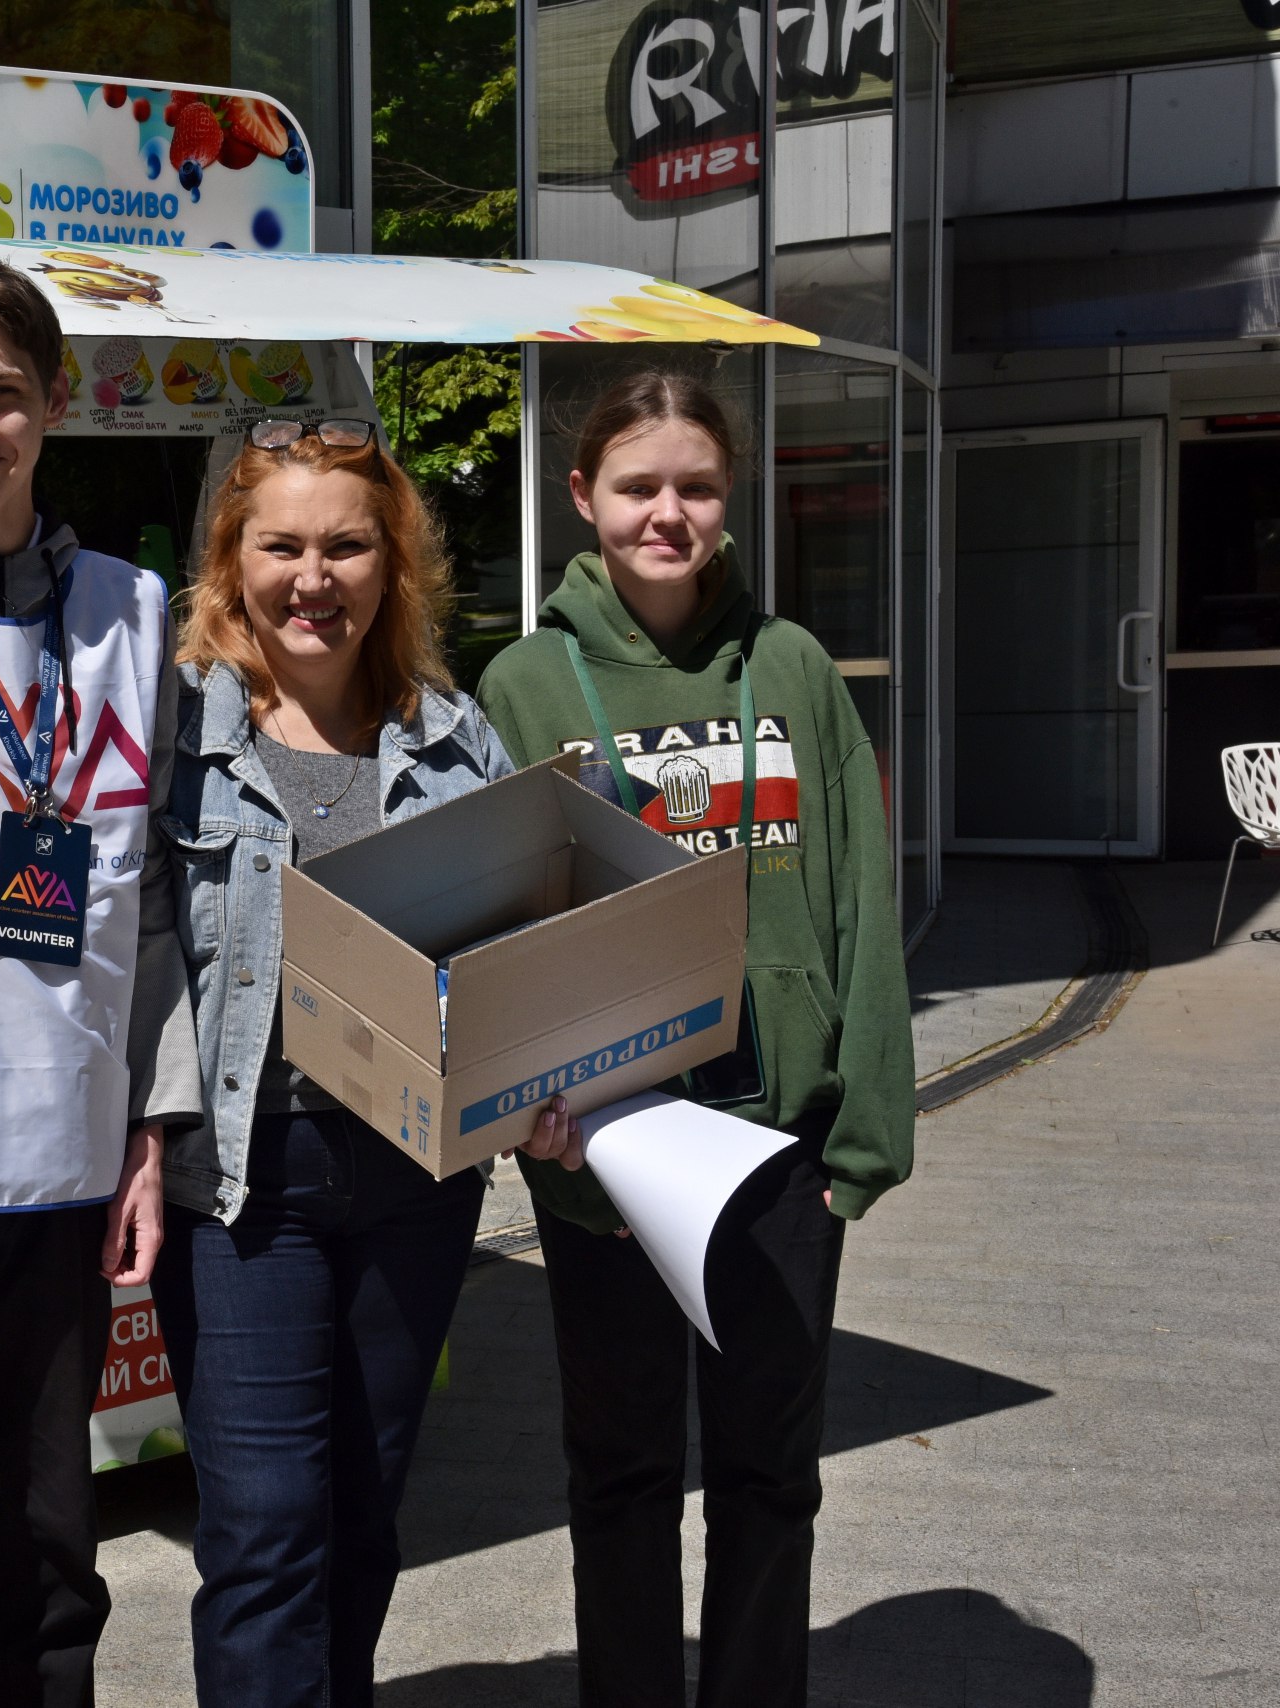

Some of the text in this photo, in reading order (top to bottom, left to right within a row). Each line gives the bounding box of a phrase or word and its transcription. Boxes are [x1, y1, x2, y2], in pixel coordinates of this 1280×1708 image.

[29, 183, 179, 220] МОРОЗИВО
[103, 421, 167, 432] ЦУКРОВОЇ ВАТИ
[121, 411, 145, 419] СМАК
[191, 410, 220, 419] МАНГО
[41, 667, 50, 698] Kharkiv
[2, 735, 18, 761] Kharkiv
[9, 728, 28, 761] Volunteer
[560, 718, 786, 756] PRAHA
[110, 851, 128, 869] of
[1, 864, 77, 912] AVA
[496, 1014, 688, 1116] МОРОЗИВО
